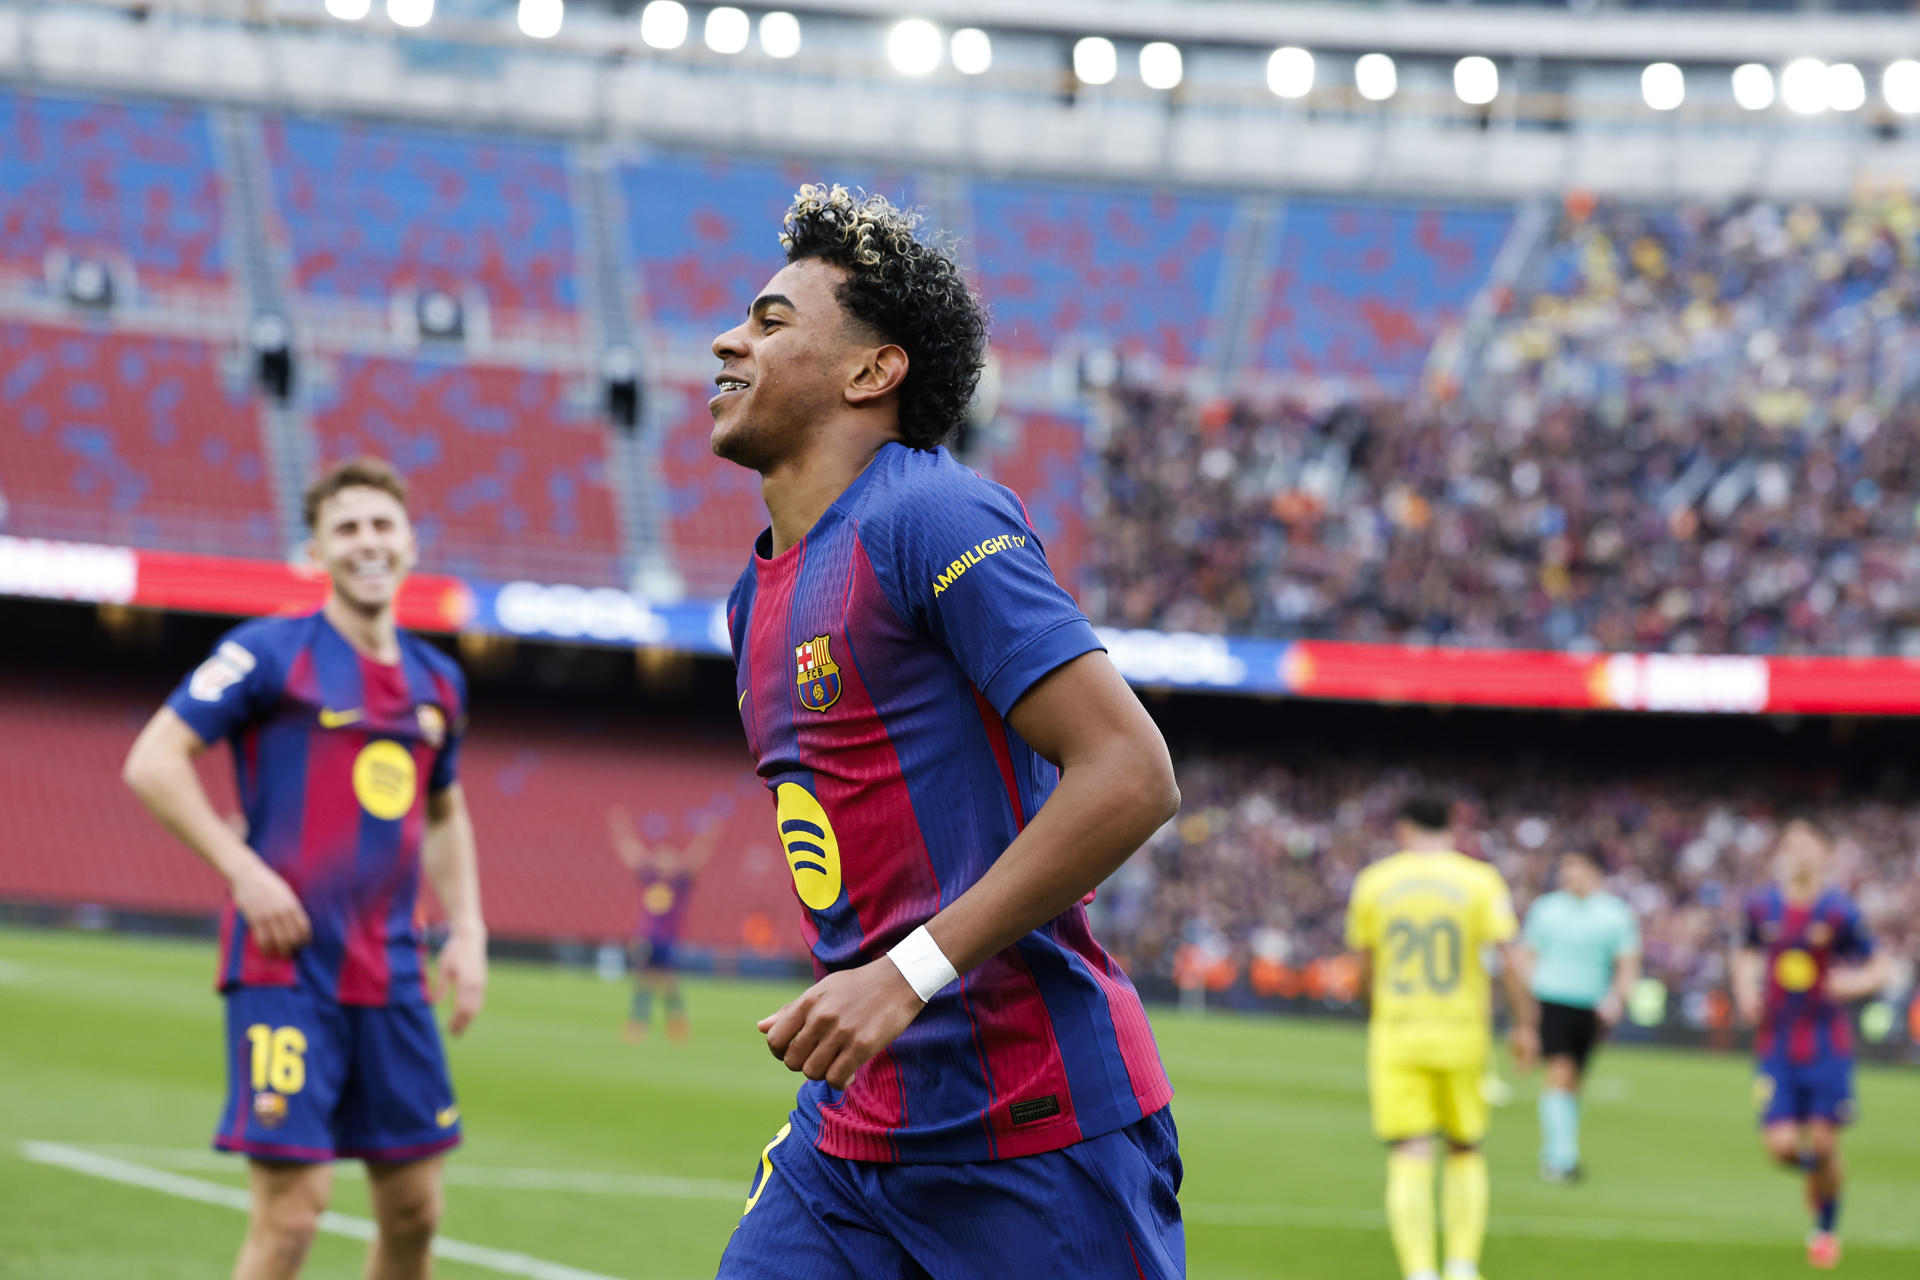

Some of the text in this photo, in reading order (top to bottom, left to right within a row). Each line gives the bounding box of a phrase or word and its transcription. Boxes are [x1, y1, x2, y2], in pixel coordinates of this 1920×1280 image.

[932, 534, 1026, 598] AMBILIGHT tv
[1383, 916, 1462, 995] 20
[246, 1023, 308, 1095] 16
